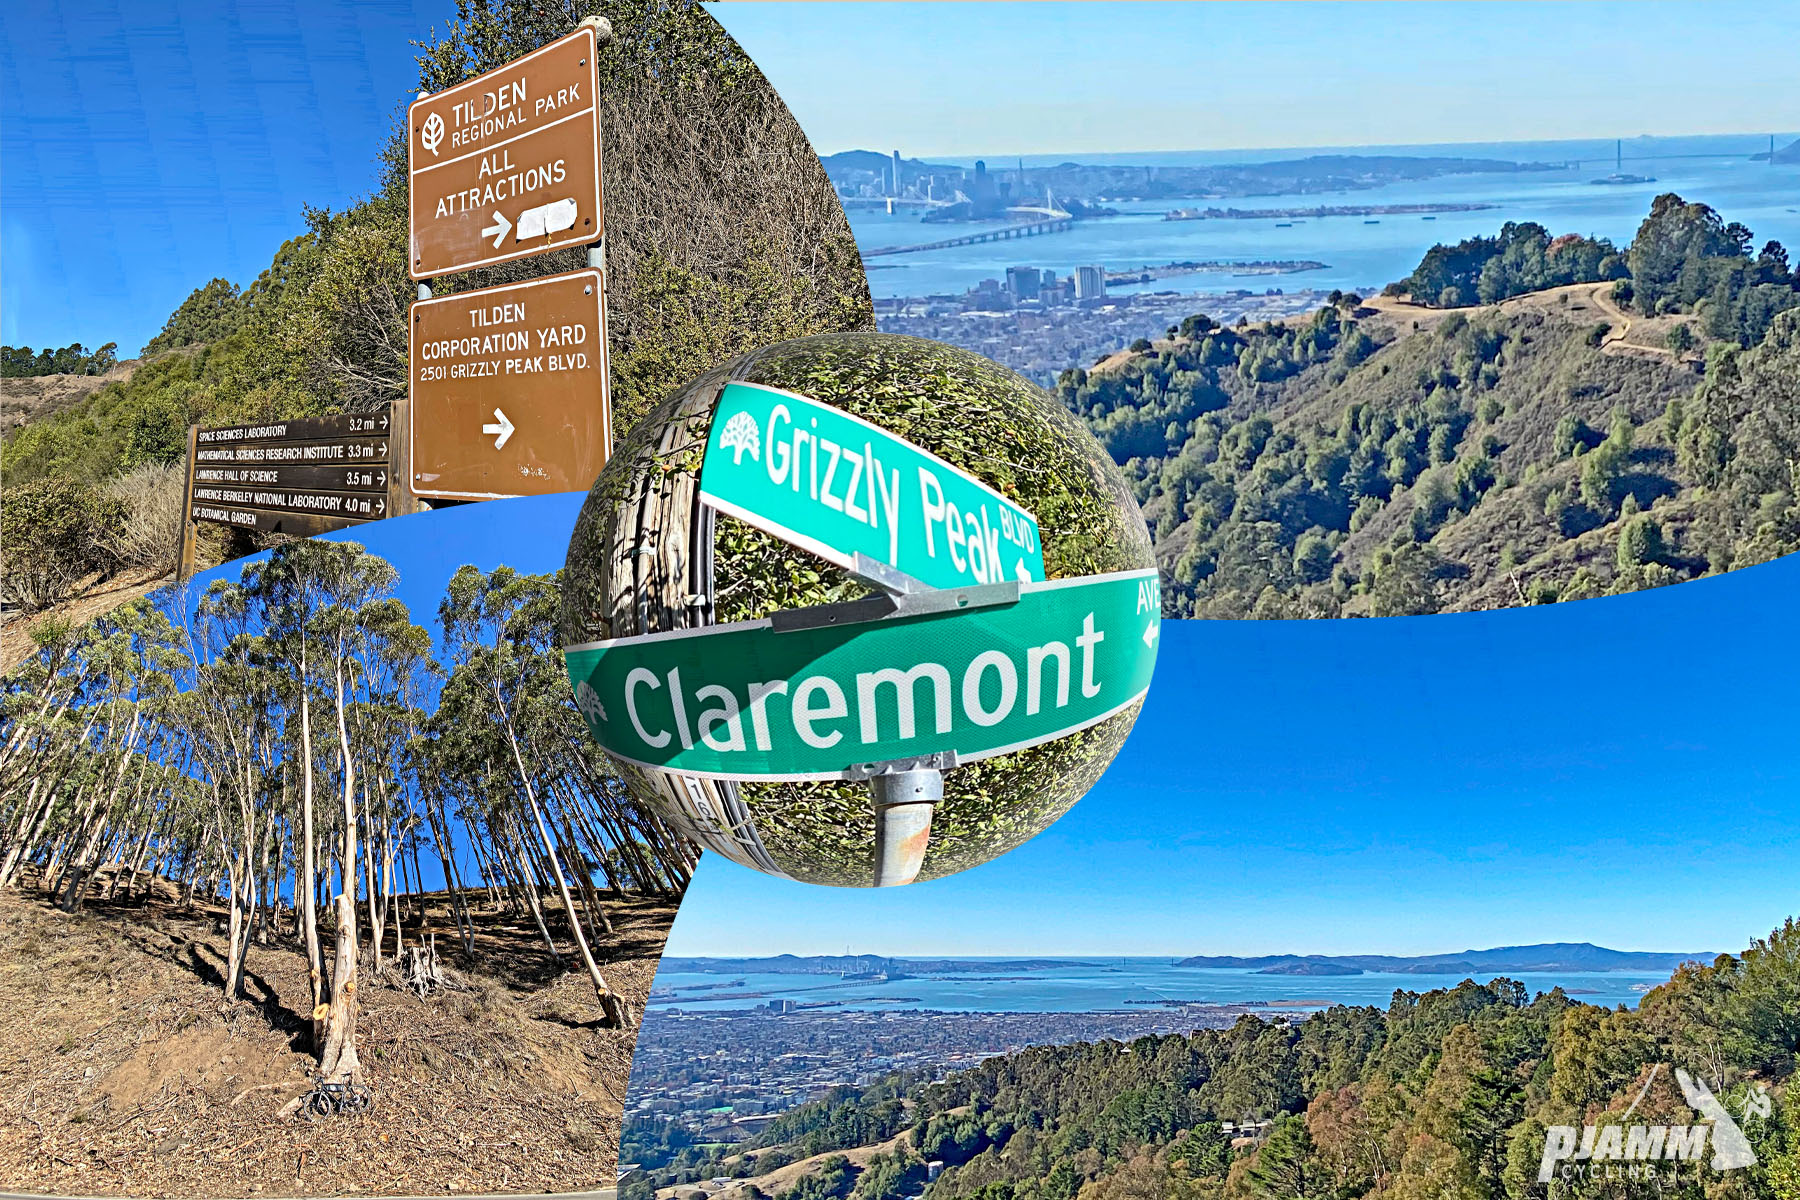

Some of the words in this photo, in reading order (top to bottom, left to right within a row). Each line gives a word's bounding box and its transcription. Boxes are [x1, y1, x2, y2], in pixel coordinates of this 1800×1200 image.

[452, 77, 526, 128] TILDEN
[452, 107, 526, 149] REGIONAL
[535, 83, 580, 116] PARK
[478, 150, 515, 179] ALL
[435, 160, 566, 219] ATTRACTIONS
[470, 303, 525, 328] TILDEN
[422, 331, 528, 360] CORPORATION
[537, 324, 586, 348] YARD
[420, 365, 446, 381] 2501
[451, 360, 500, 379] GRIZZLY
[506, 357, 543, 374] PEAK
[549, 353, 590, 372] BLVD.
[199, 432, 215, 442] SPACE
[216, 429, 243, 440] SCIENCES
[245, 425, 287, 439] LABORATORY
[350, 418, 362, 431] 3.2
[364, 417, 374, 430] mi
[198, 450, 234, 460] MATHEMATICAL
[236, 449, 264, 460] SCIENCES
[266, 448, 302, 459] RESEARCH
[304, 446, 343, 458] INSTITUTE
[348, 445, 360, 457] 3.3
[363, 444, 374, 457] mi
[196, 470, 223, 480] LAWRENCE
[224, 470, 239, 480] HALL
[240, 471, 248, 480] OF
[250, 471, 278, 482] SCIENCE
[347, 472, 359, 485] 3.5
[362, 472, 372, 485] mi
[194, 488, 222, 500] LAWRENCE
[223, 490, 253, 502] BERKELEY
[254, 492, 286, 506] NATIONAL
[288, 495, 342, 510] LABORATORY
[345, 498, 358, 511] 4.0
[360, 499, 370, 512] mi
[765, 404, 899, 568] Grizzly
[918, 466, 1004, 584] Peak
[193, 507, 200, 516] UC
[201, 509, 229, 522] BOTANICAL
[231, 512, 256, 525] GARDEN
[999, 504, 1034, 554] BLVD
[1136, 578, 1160, 616] AVE
[624, 612, 1104, 752] Claremont
